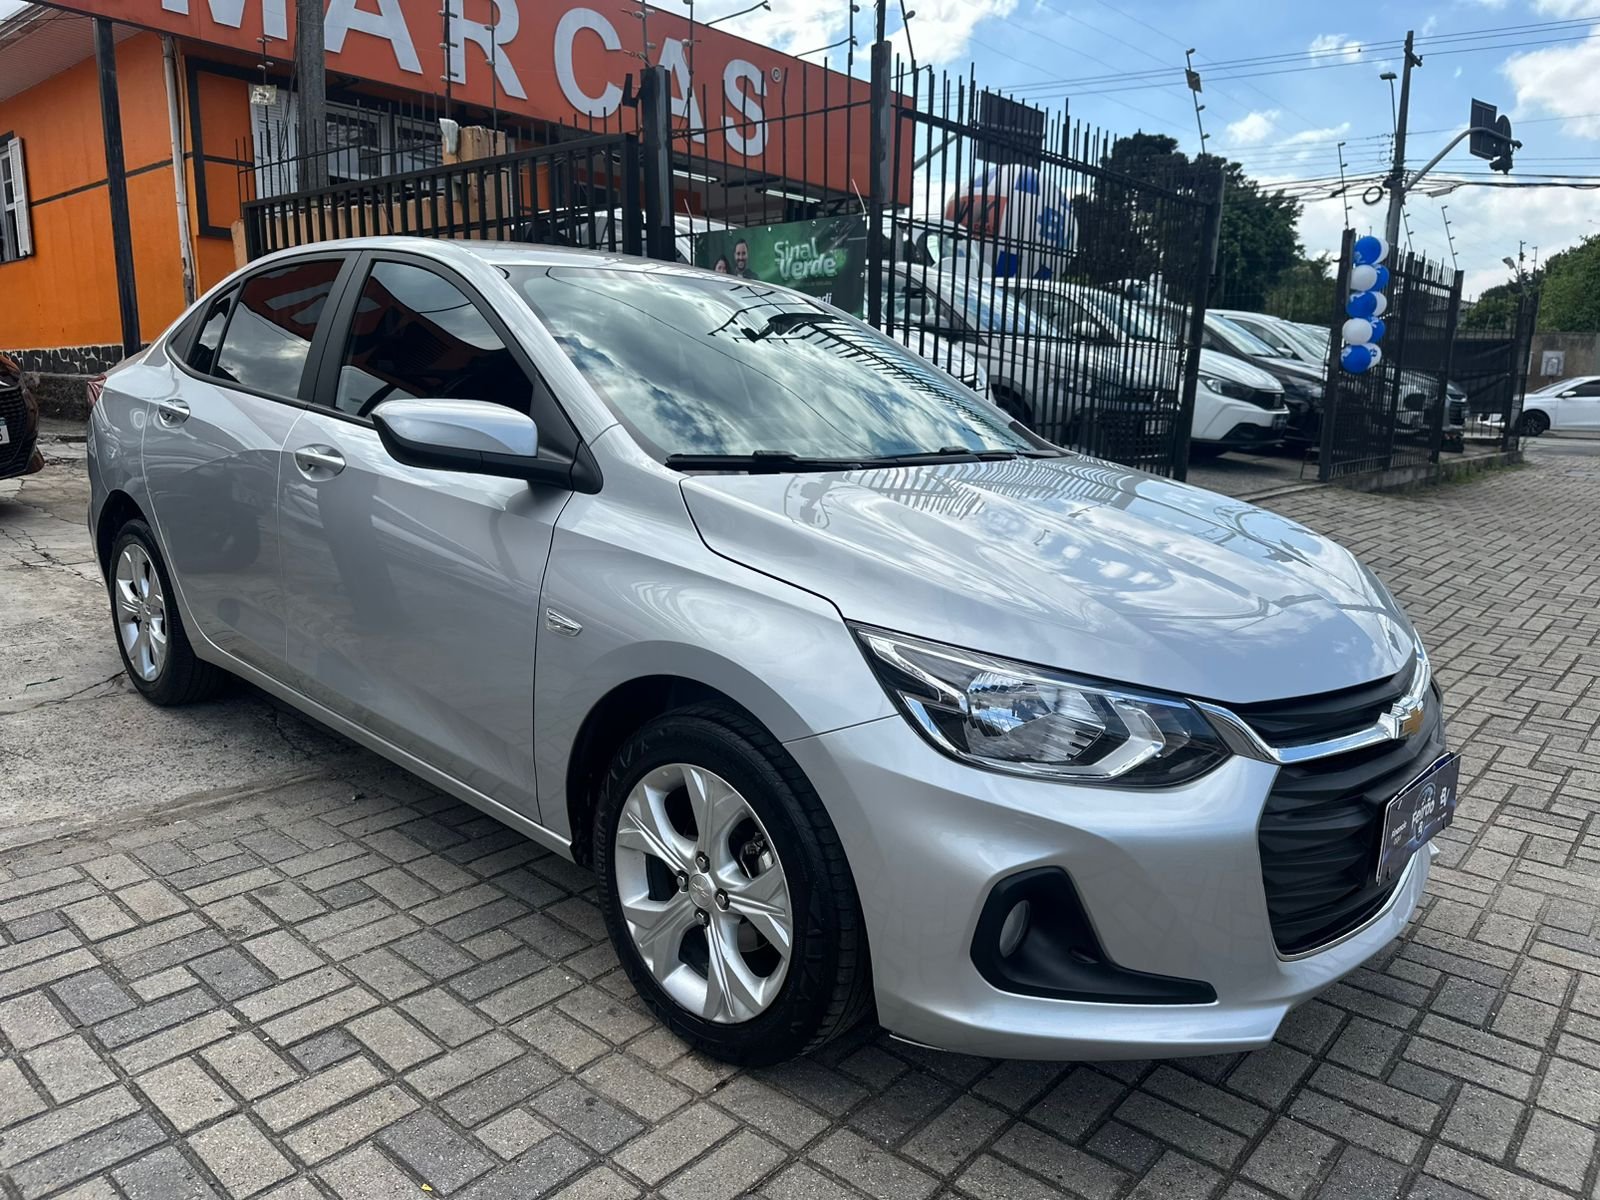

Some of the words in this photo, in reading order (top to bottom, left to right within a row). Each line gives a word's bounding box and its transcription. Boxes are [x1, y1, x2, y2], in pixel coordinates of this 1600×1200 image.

[162, 0, 769, 157] ARCAS
[774, 237, 818, 260] Sinal
[775, 253, 837, 279] Verde
